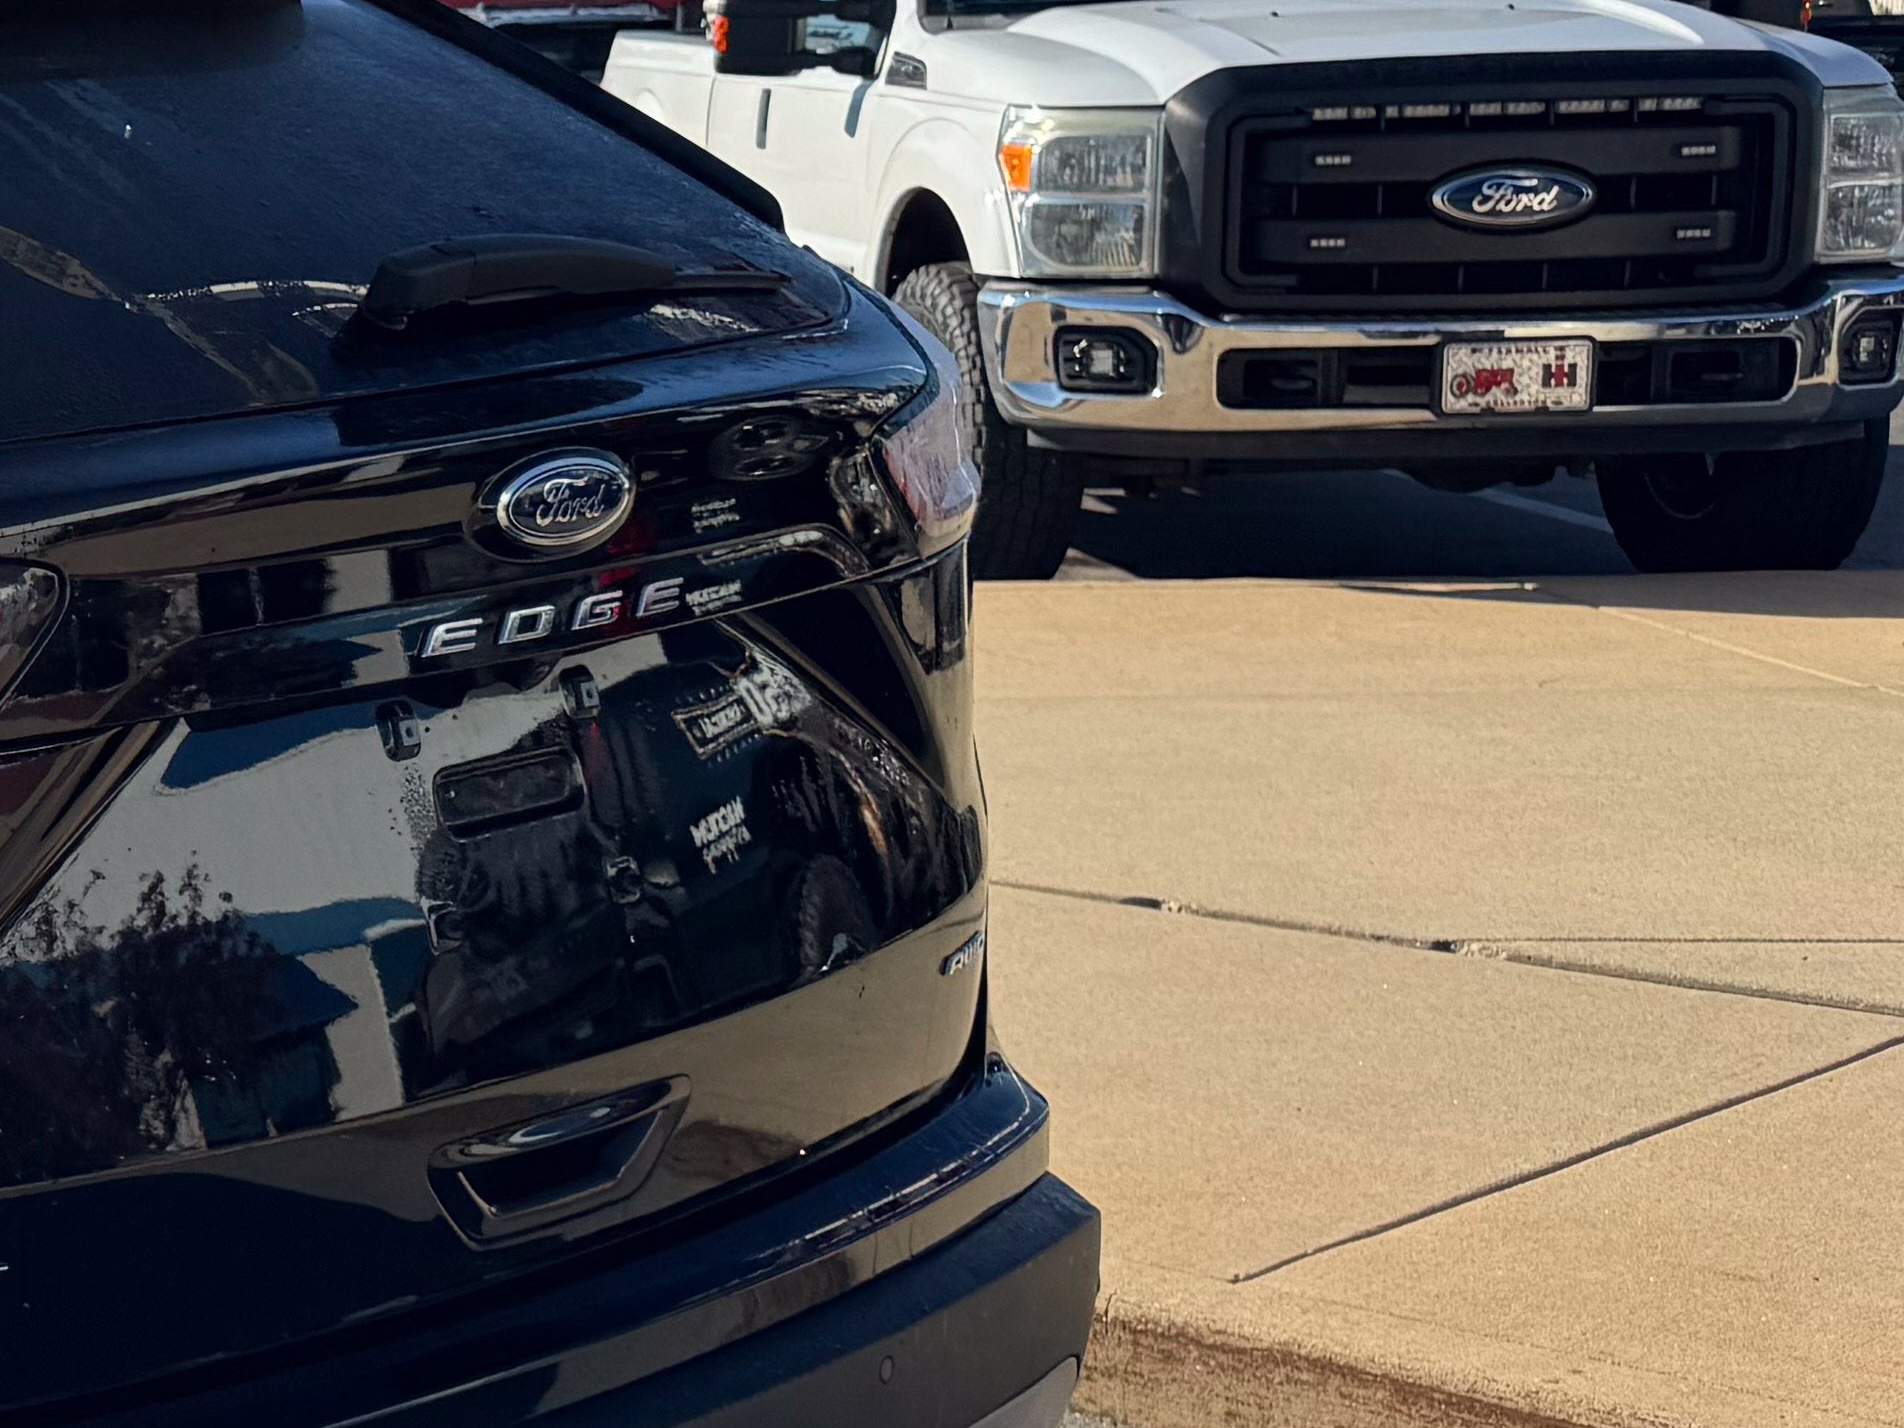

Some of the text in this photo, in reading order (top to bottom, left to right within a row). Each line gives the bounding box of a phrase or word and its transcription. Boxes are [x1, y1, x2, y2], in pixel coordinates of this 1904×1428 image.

[1471, 178, 1560, 213] Ford
[535, 476, 605, 527] Ford
[418, 576, 685, 658] EDGE
